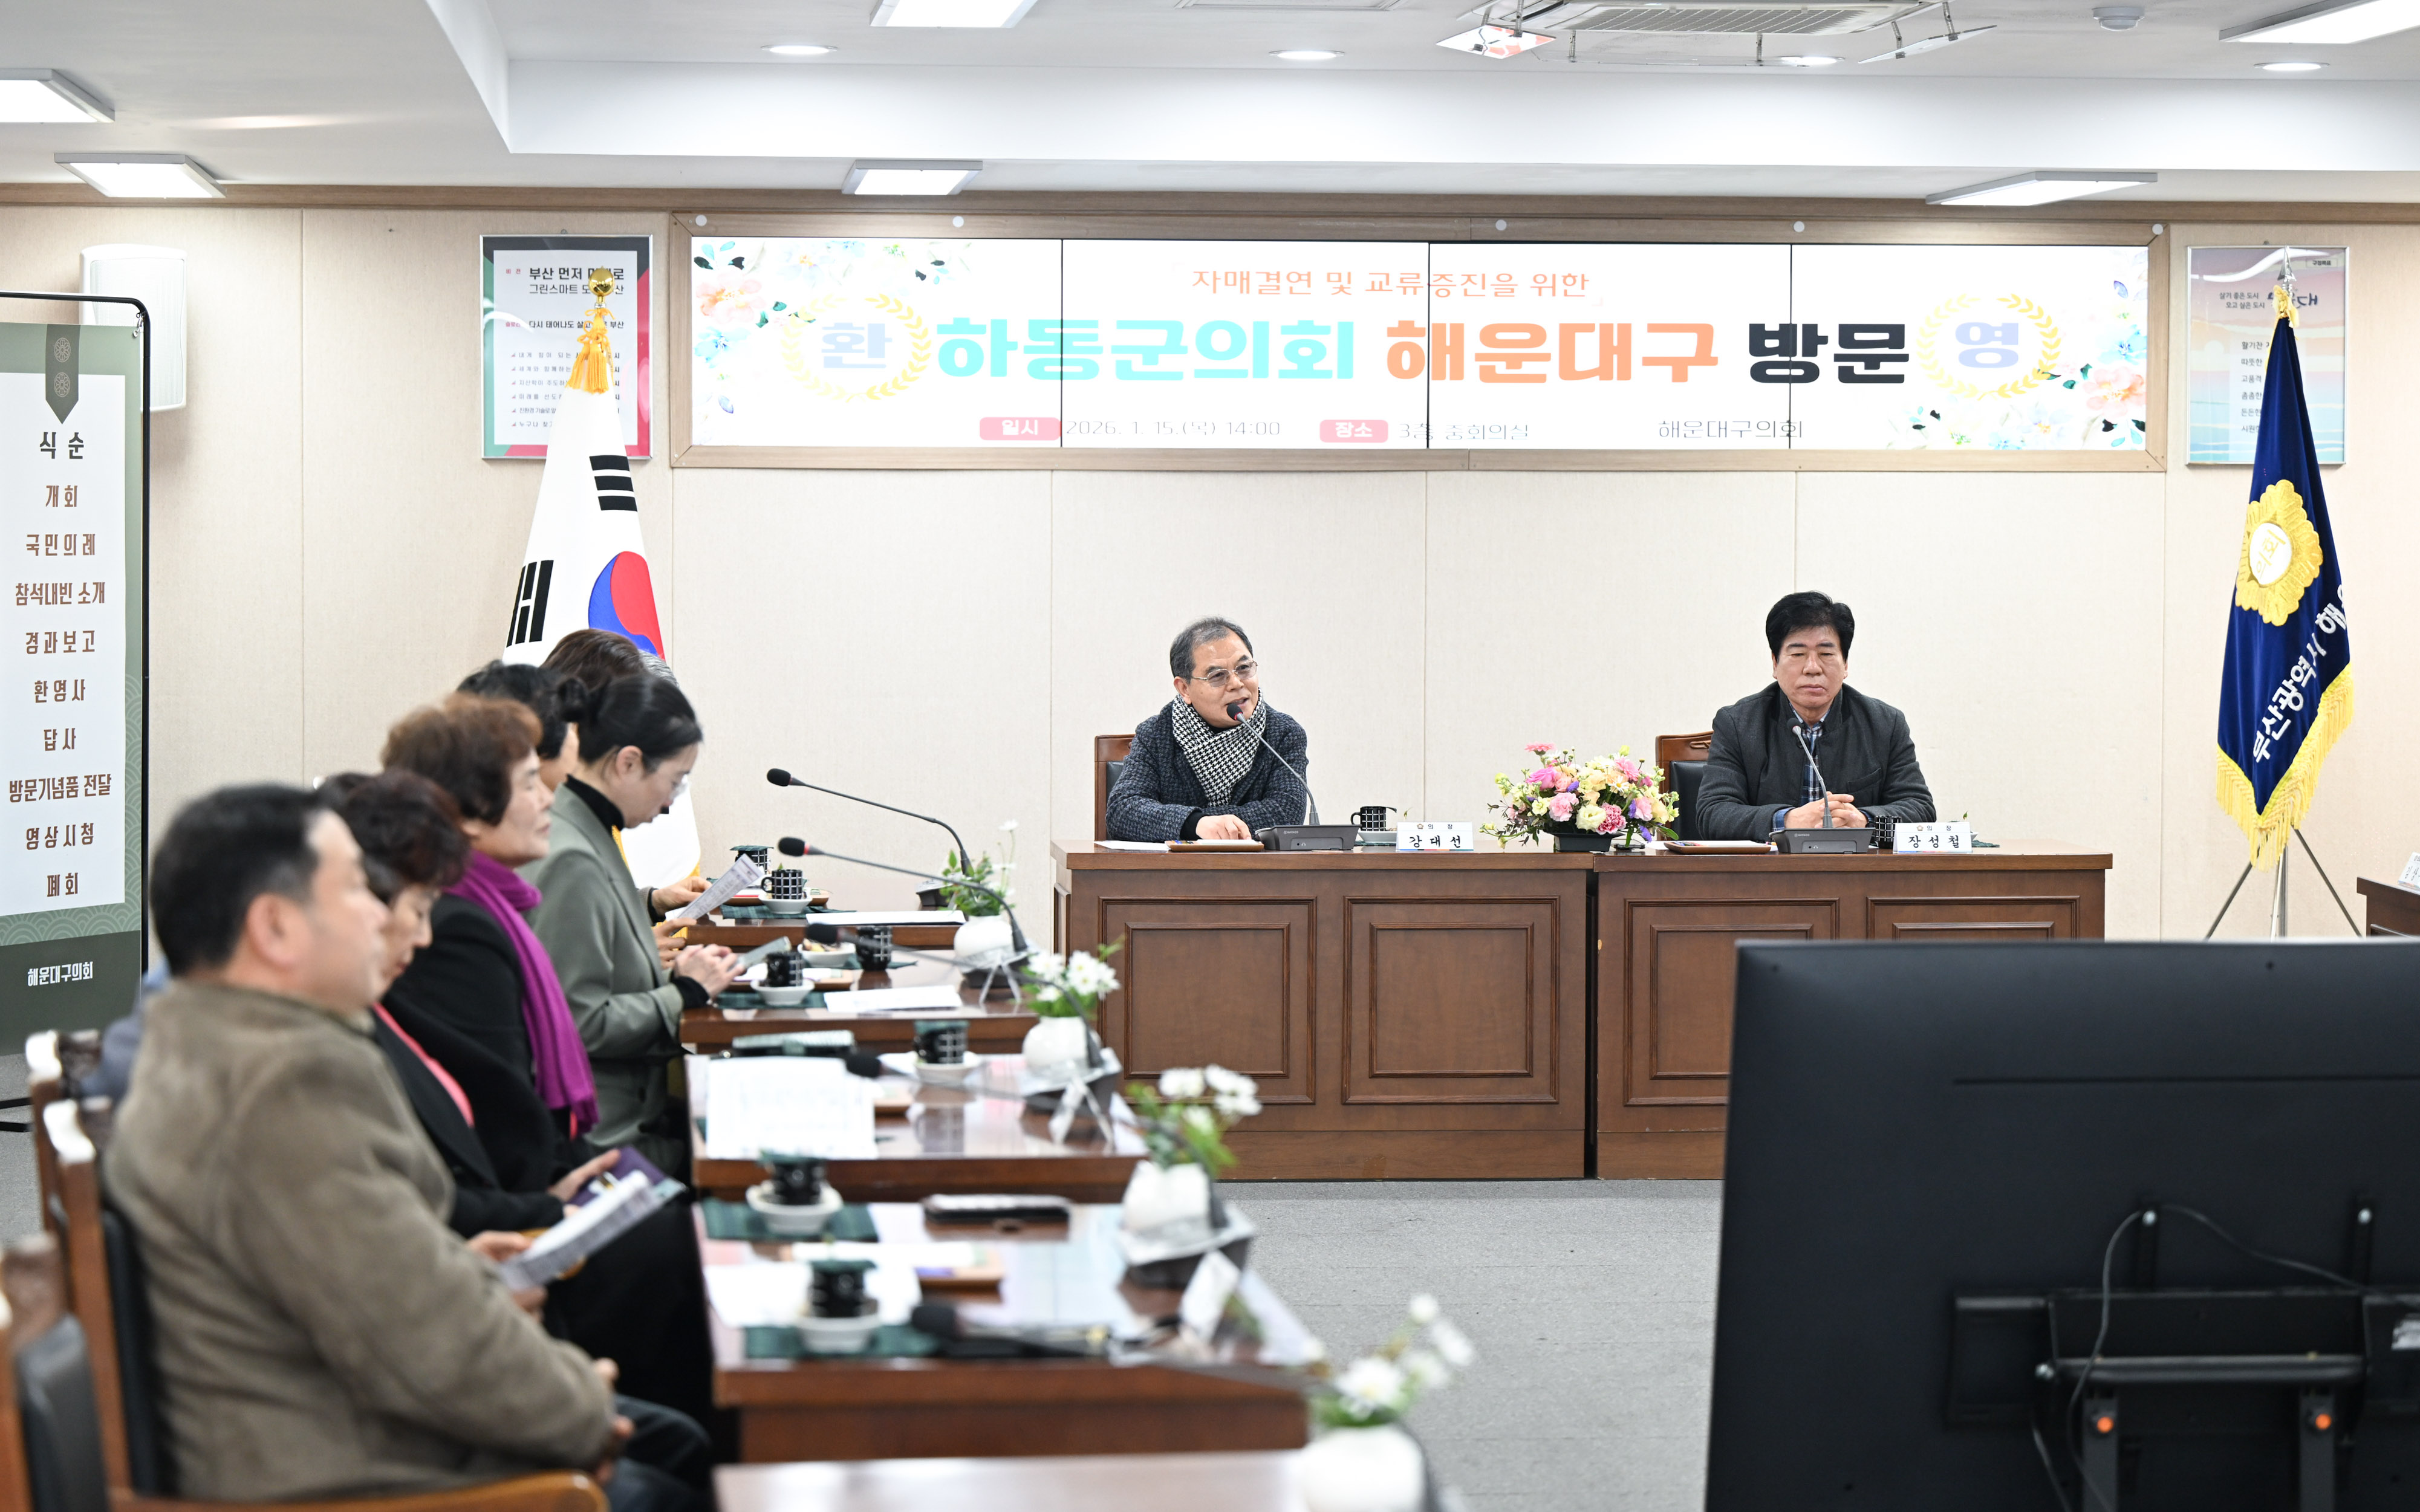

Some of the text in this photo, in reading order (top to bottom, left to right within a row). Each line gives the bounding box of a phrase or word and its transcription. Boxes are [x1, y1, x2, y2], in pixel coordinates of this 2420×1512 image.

[529, 268, 554, 280] 부산
[559, 268, 582, 280] 먼저
[1192, 271, 1590, 297] 자매결연 및 교류증진을 위한
[529, 284, 578, 294] 그린스마트
[821, 322, 893, 369] 환
[936, 317, 1910, 384] 하동군의회 해운대구 방문
[1955, 322, 2020, 369] 영
[2241, 358, 2262, 366] 따뜻한
[1001, 419, 1038, 436] 일시
[1066, 421, 1122, 435] 2026.
[1228, 421, 1280, 435] 14:00
[1335, 422, 1373, 438] 장소
[1659, 420, 1802, 438] 해운대구의회
[39, 432, 84, 459] 식순
[45, 485, 77, 507] 개회
[26, 534, 96, 556] 국민의례
[15, 582, 105, 606] 참석내빈 소개
[26, 631, 95, 654] 경과보고
[34, 679, 85, 703] 환영사
[44, 728, 76, 751] 답사
[9, 774, 111, 803] 방문기념품 전달
[26, 823, 94, 850] 영상시청
[47, 872, 78, 897] 폐회
[27, 961, 93, 987] 해운대구의회
